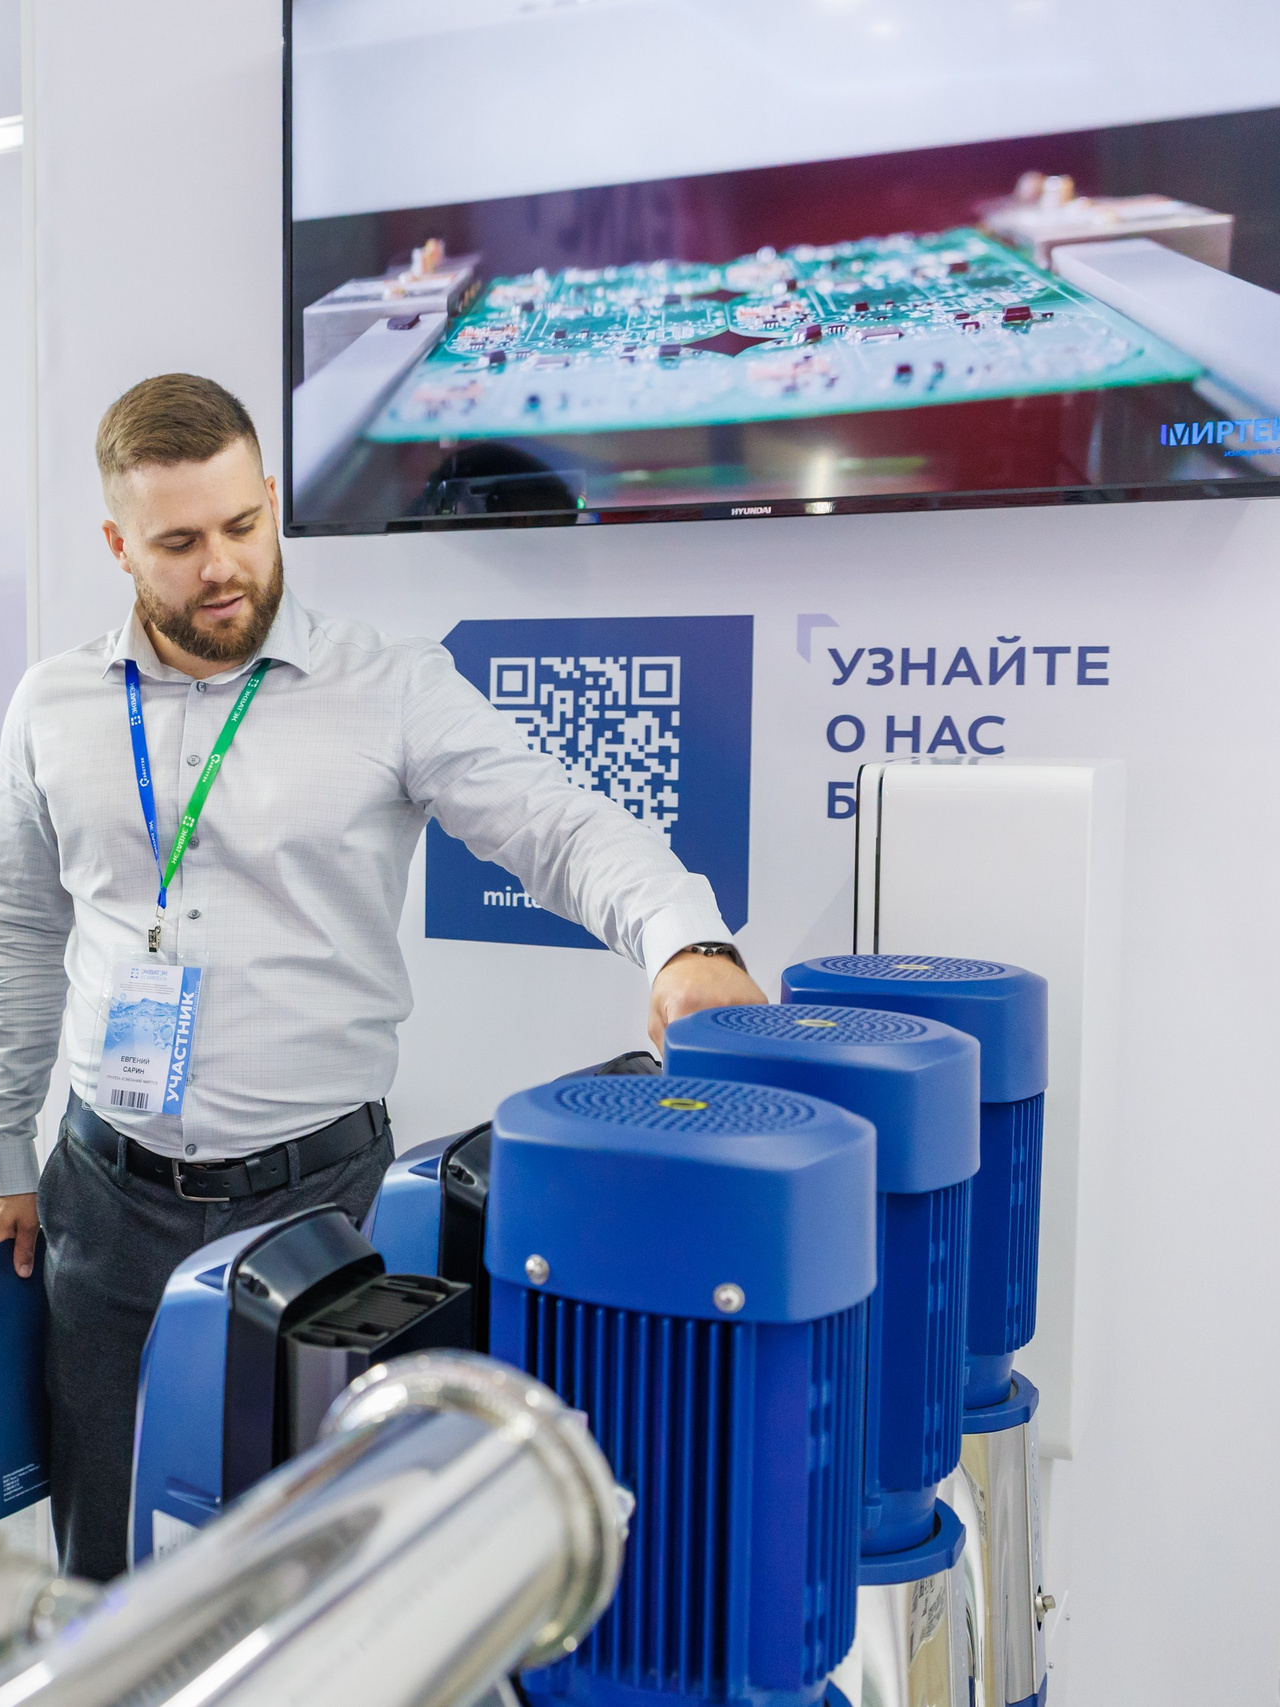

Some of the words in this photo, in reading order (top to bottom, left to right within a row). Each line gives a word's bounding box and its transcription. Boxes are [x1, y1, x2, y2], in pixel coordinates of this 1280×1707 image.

[731, 506, 772, 515] HYUNDAI
[827, 635, 1110, 686] УЗНАЙТЕ
[826, 714, 866, 753] О
[885, 715, 1006, 755] НАС
[171, 827, 188, 865] ЭКВАТЭК
[121, 1055, 150, 1065] ЕВГЕНИЙ
[167, 992, 195, 1102] УЧАСТНИК
[123, 1066, 145, 1074] САРИН
